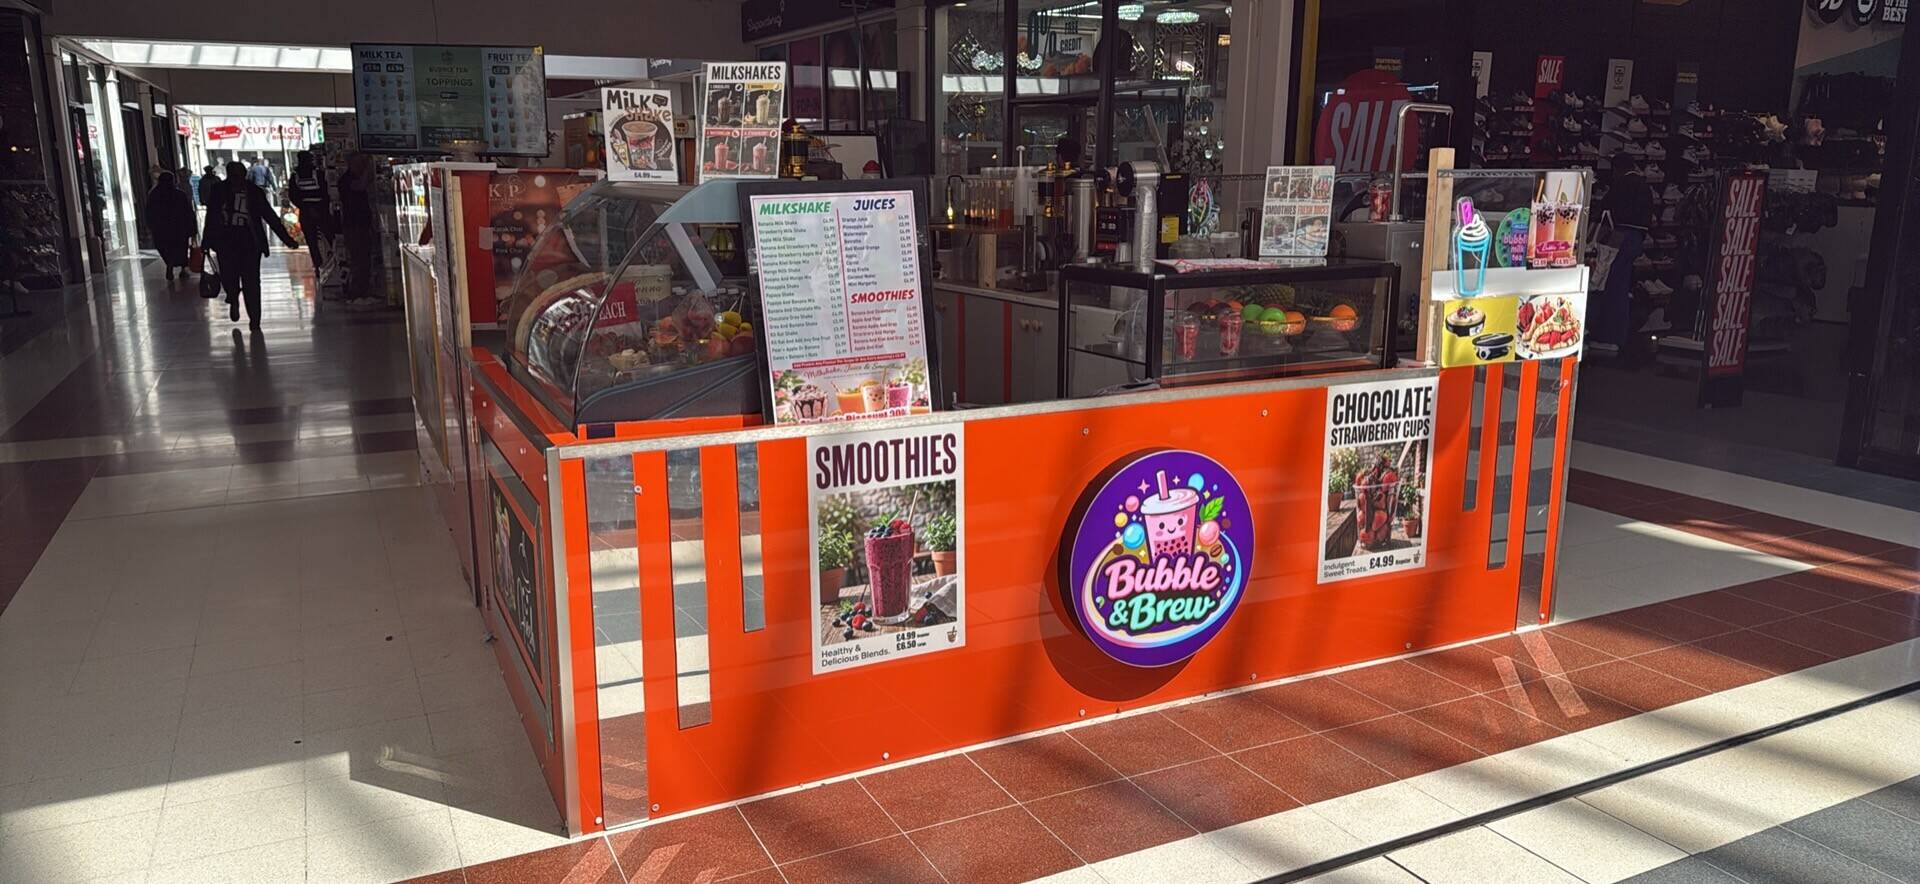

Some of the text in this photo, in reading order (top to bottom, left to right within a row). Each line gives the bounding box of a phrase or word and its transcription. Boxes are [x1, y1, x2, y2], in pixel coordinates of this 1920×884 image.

[1882, 7, 1907, 23] BEST
[1060, 37, 1081, 52] CREDIT
[360, 51, 403, 59] MILK TEA
[488, 53, 513, 62] FRUIT
[712, 65, 782, 80] MILKSHAKES
[1538, 59, 1562, 84] SALE
[426, 78, 473, 87] TOPPINGS
[853, 199, 895, 211] JUICES
[1725, 179, 1764, 218] SALE
[759, 201, 831, 215] MILKSHAKE
[1503, 233, 1528, 245] bubbl
[1721, 217, 1759, 256] SALE
[1717, 255, 1755, 294] SALE
[851, 290, 914, 304] SMOOTHIES
[1713, 292, 1750, 331] SALE
[1708, 329, 1745, 367] SALE
[1332, 386, 1433, 425] CHOCOLATE
[1331, 418, 1430, 446] STRAWBERRY CUPS
[816, 433, 957, 490] SMOOTHIES
[1324, 560, 1355, 571] Indulgent
[1369, 555, 1394, 570] £4.99
[1105, 556, 1220, 599] Bubble
[1324, 565, 1368, 579] Sweet Treats.
[896, 631, 916, 642] £4.99
[821, 644, 861, 659] Healthy &
[896, 640, 917, 651] £6.50
[821, 648, 891, 668] Delicious Blends.
